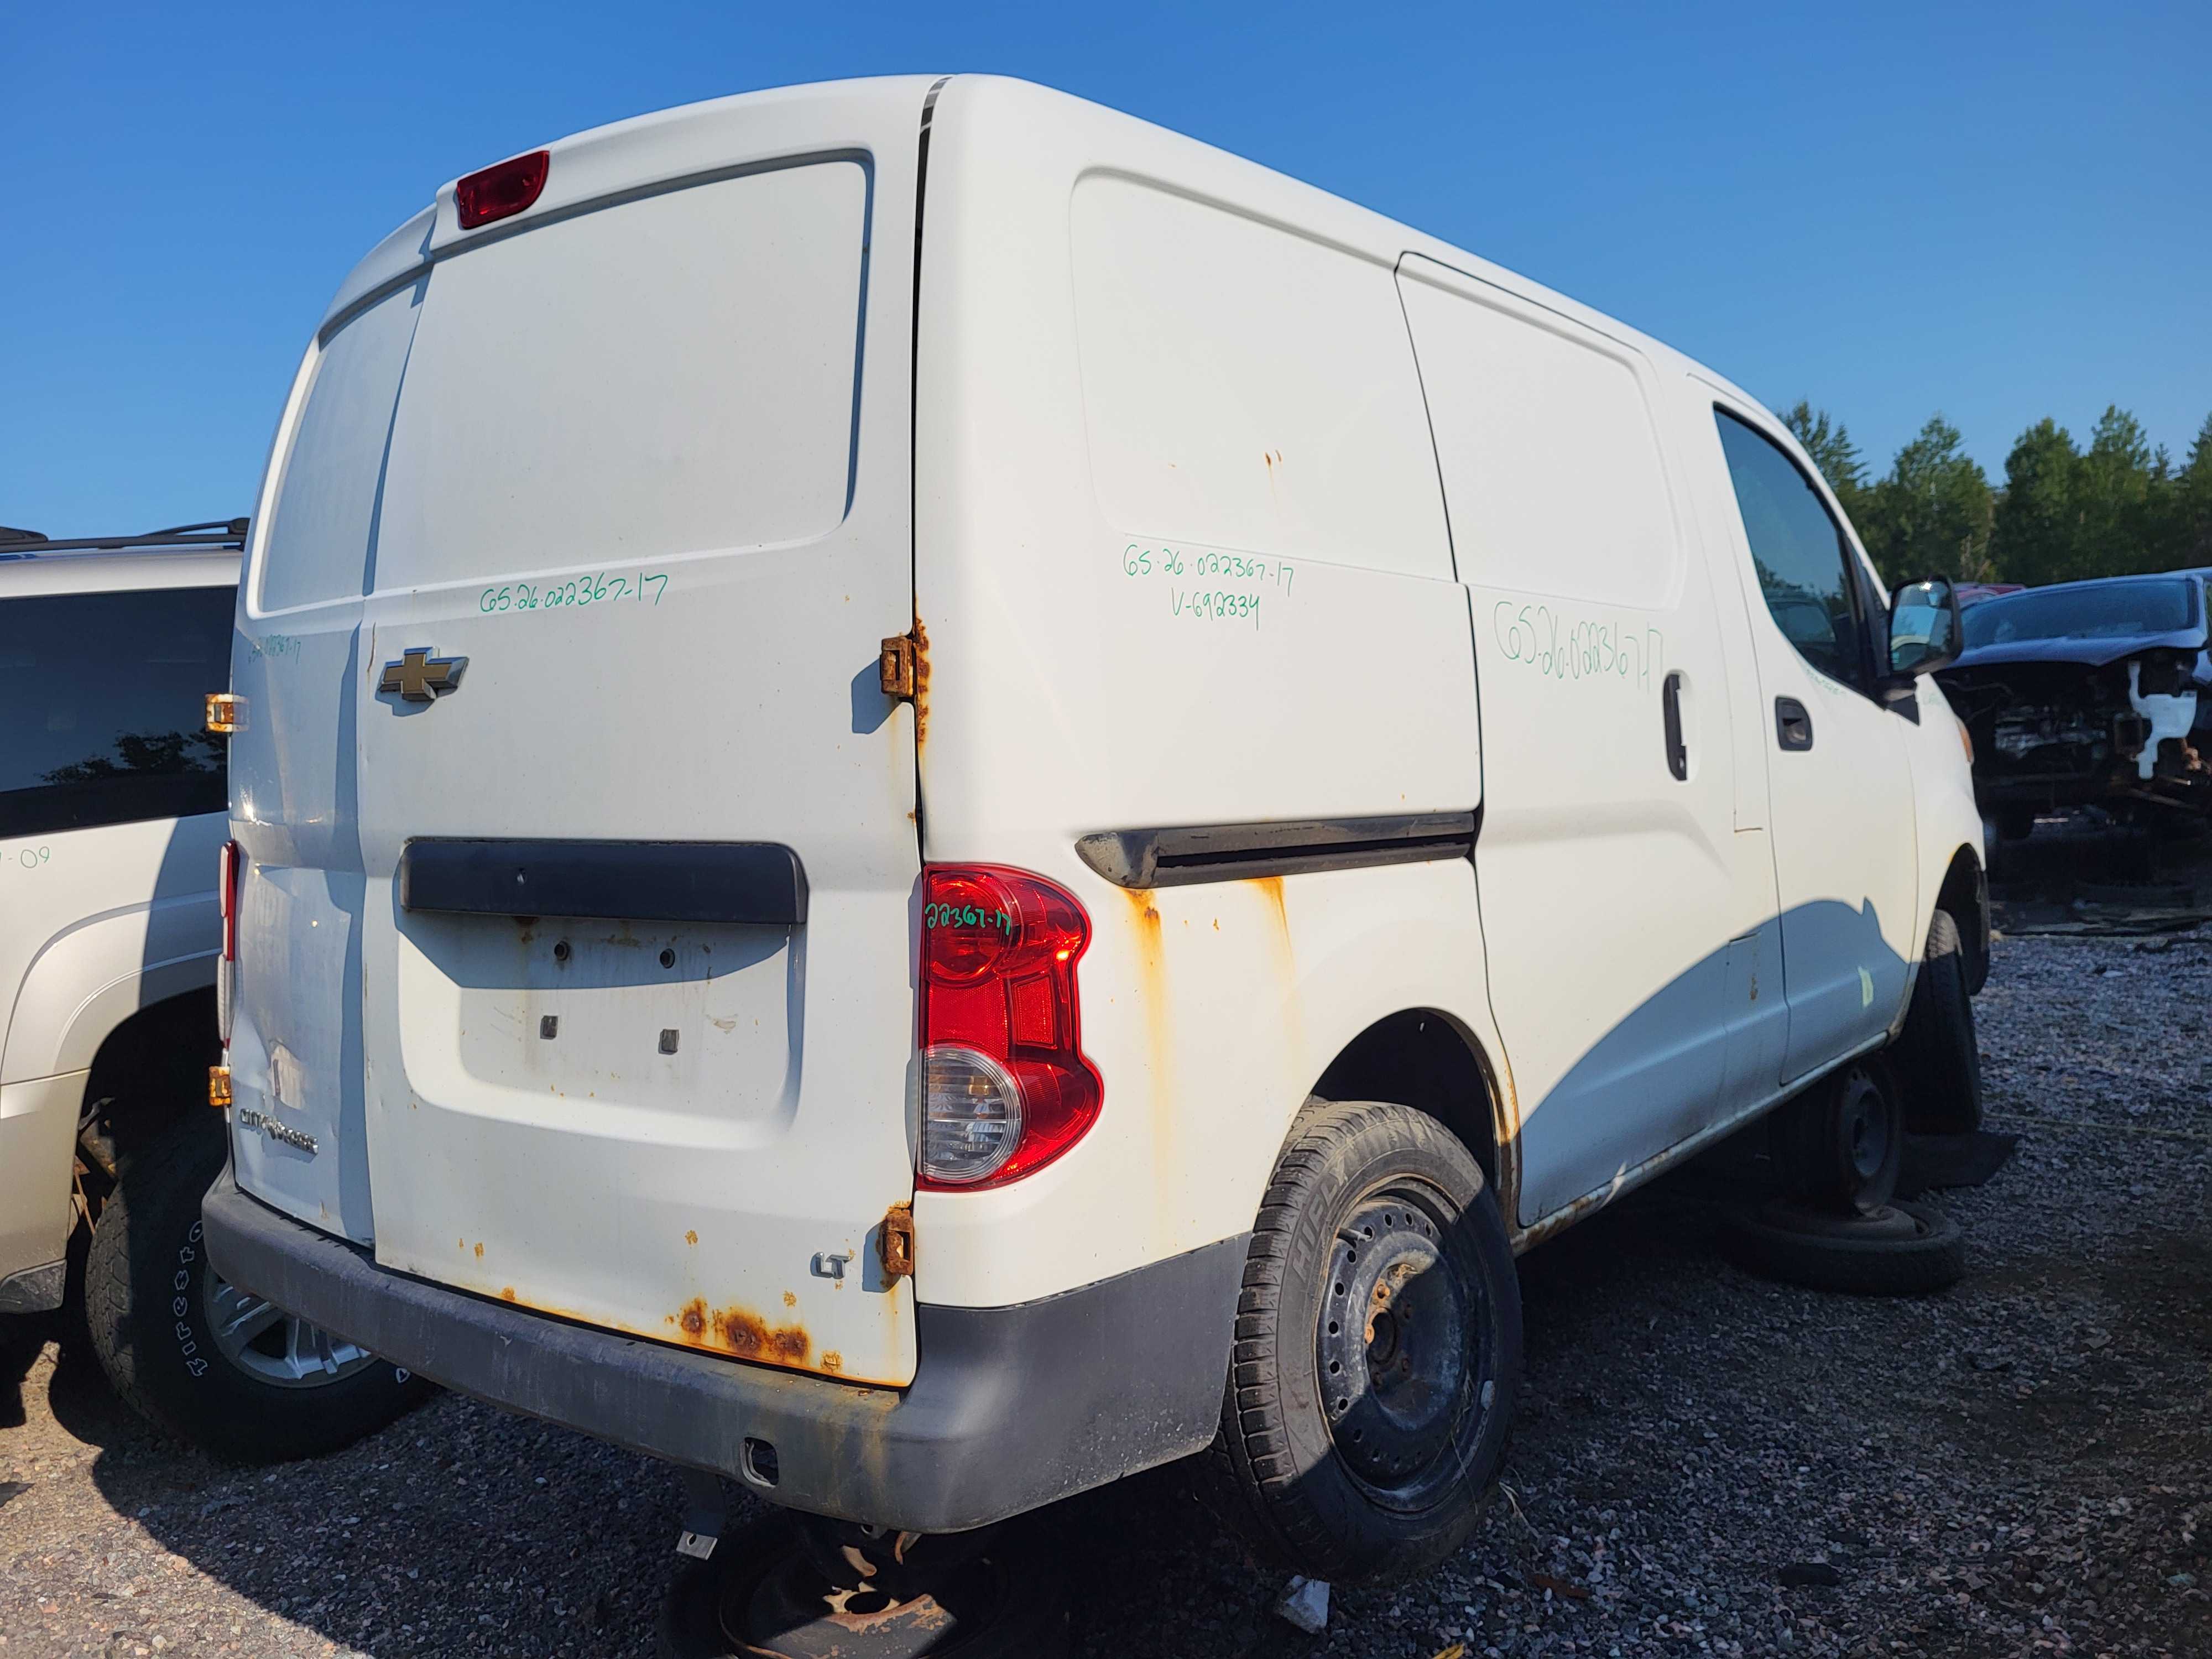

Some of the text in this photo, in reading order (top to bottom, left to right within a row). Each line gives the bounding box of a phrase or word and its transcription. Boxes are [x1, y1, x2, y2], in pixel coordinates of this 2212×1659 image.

[0, 846, 50, 869] -09
[810, 1251, 851, 1280] LT
[173, 1220, 208, 1376] Firesto
